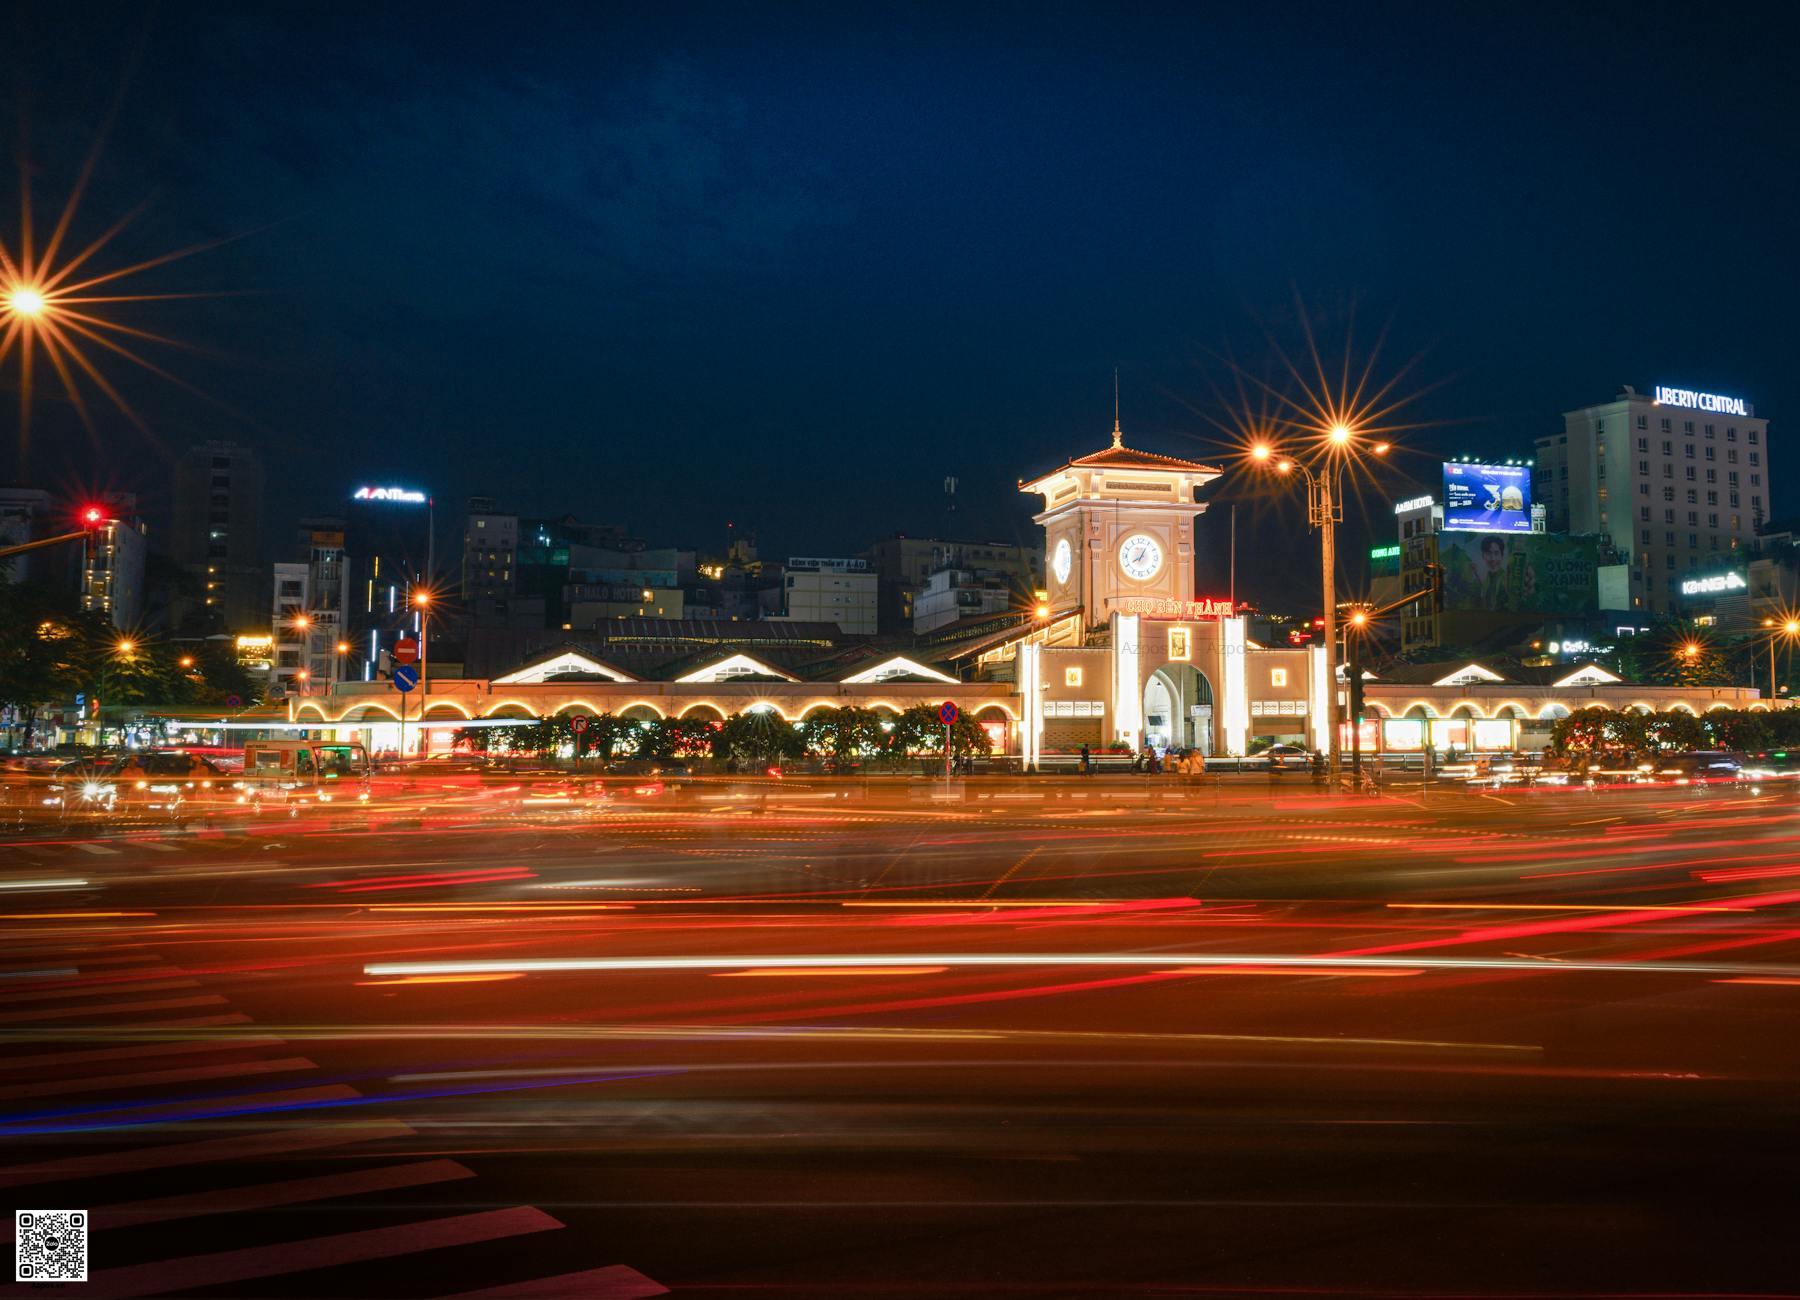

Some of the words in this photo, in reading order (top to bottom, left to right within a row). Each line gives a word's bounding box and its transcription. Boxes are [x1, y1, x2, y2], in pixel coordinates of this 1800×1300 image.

[1656, 386, 1698, 408] LIBERTY
[1699, 393, 1747, 416] CENTRAL
[1126, 599, 1154, 615] CHỢ
[1156, 597, 1183, 615] BẾN
[1186, 599, 1233, 616] THÀNH
